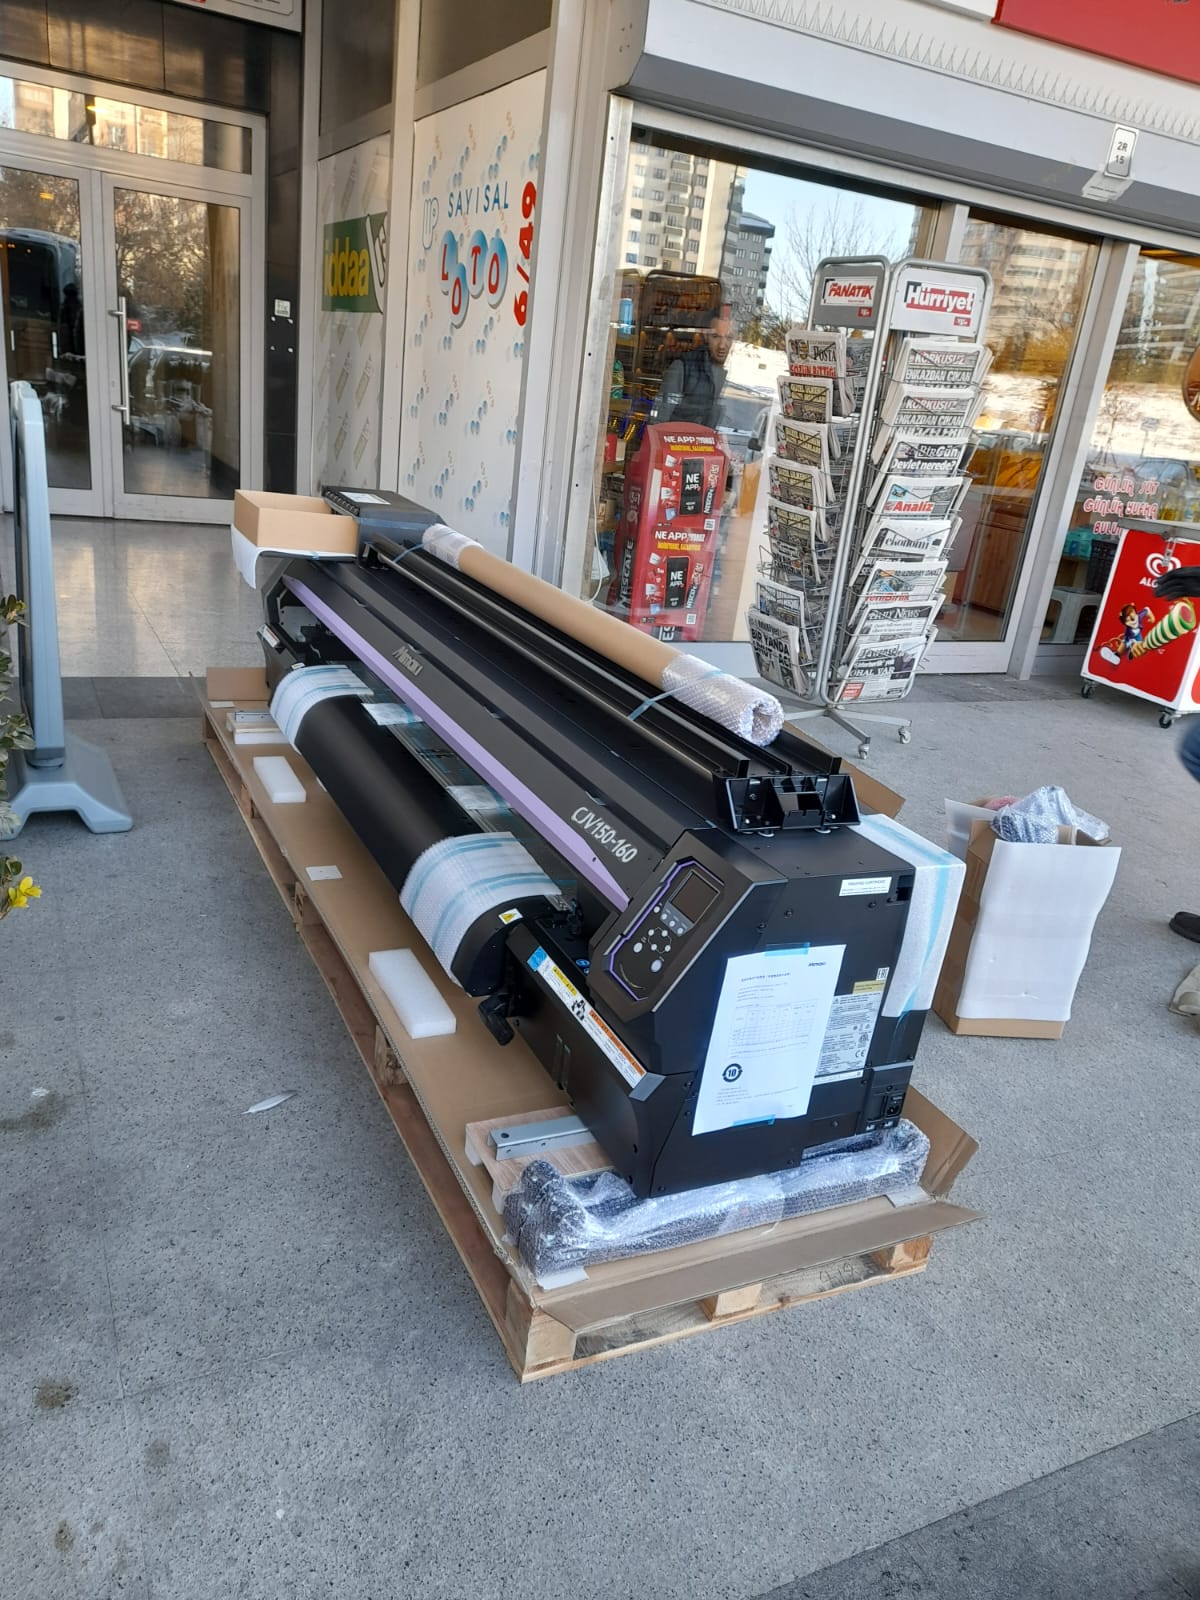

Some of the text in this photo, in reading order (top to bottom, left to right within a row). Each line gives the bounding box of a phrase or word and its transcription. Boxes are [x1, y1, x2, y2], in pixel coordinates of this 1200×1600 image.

[1116, 141, 1128, 152] 2R
[1115, 155, 1125, 164] 15
[447, 181, 509, 218] SAYISAL
[513, 181, 537, 326] 6/49
[324, 236, 369, 296] iddaa
[441, 243, 500, 316] LOTO
[906, 284, 975, 312] Hürriyet
[813, 346, 837, 361] POSTA
[914, 352, 966, 365] KORKUSUZ
[905, 398, 958, 410] KORKUSUZ
[891, 459, 957, 471] Devlet nerede?
[685, 473, 700, 483] NE
[654, 530, 668, 540] NE
[1093, 521, 1123, 537] BULUN
[670, 570, 684, 580] NE
[1139, 577, 1159, 589] ALG
[570, 806, 638, 863] CJV150-160
[727, 1068, 737, 1078] 10
